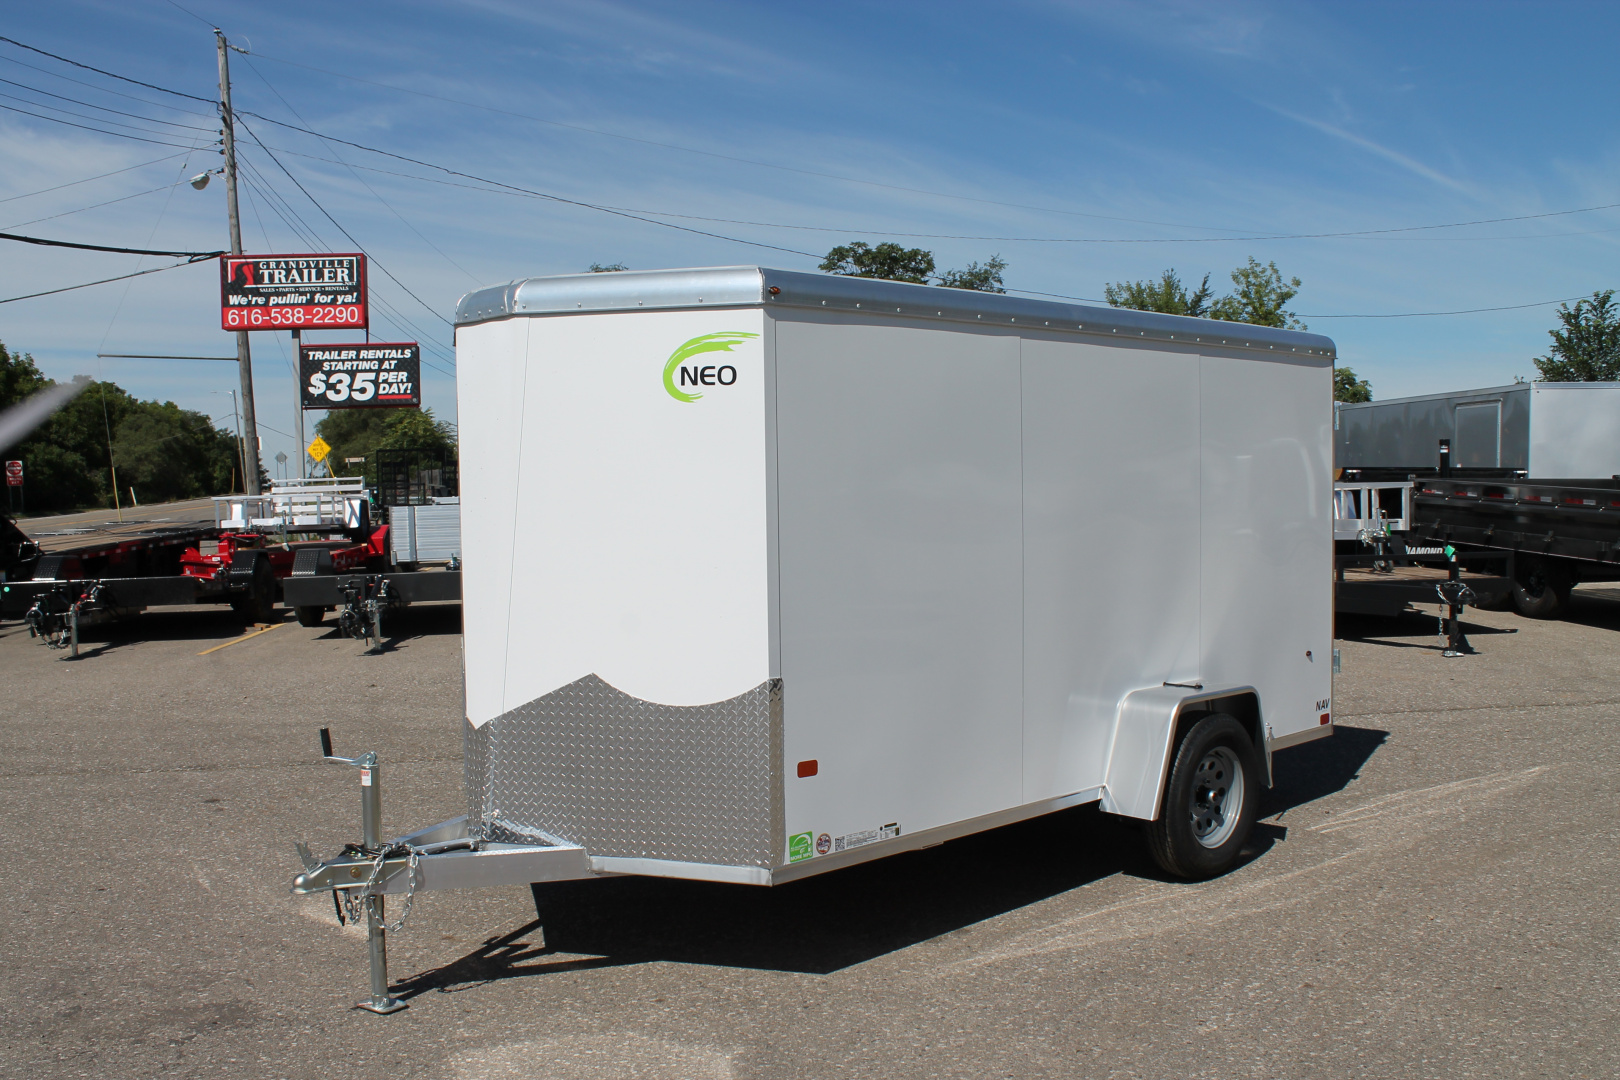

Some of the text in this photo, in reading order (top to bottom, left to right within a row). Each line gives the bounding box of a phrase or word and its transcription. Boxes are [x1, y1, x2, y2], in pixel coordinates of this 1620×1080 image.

[259, 260, 350, 269] GRANDVILLE
[259, 268, 350, 284] TRAILER
[228, 292, 357, 306] We're pullin' for ya!
[228, 306, 359, 325] 616-538-2290
[308, 349, 412, 360] TRAILER RENTALS
[322, 360, 398, 371] STARTING AT
[378, 371, 408, 383] PER
[680, 365, 737, 386] NEO
[308, 371, 376, 402] $35
[378, 383, 412, 394] DAY!
[1315, 698, 1330, 711] NAV
